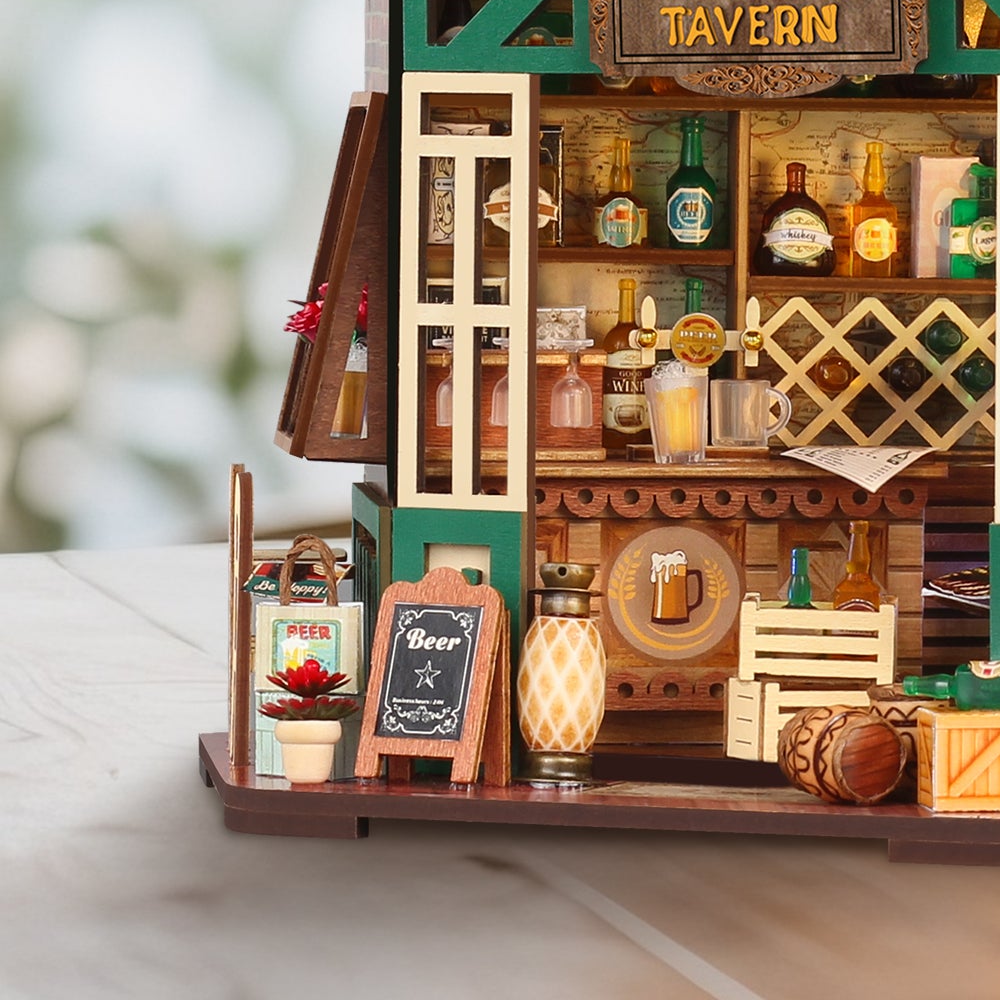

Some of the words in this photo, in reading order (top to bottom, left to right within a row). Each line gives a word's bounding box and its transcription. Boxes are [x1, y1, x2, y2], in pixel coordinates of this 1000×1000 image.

[660, 3, 838, 47] TAVERN
[253, 580, 276, 591] Be
[290, 582, 329, 597] oppy!
[286, 624, 332, 640] BEER
[406, 627, 462, 651] Beer
